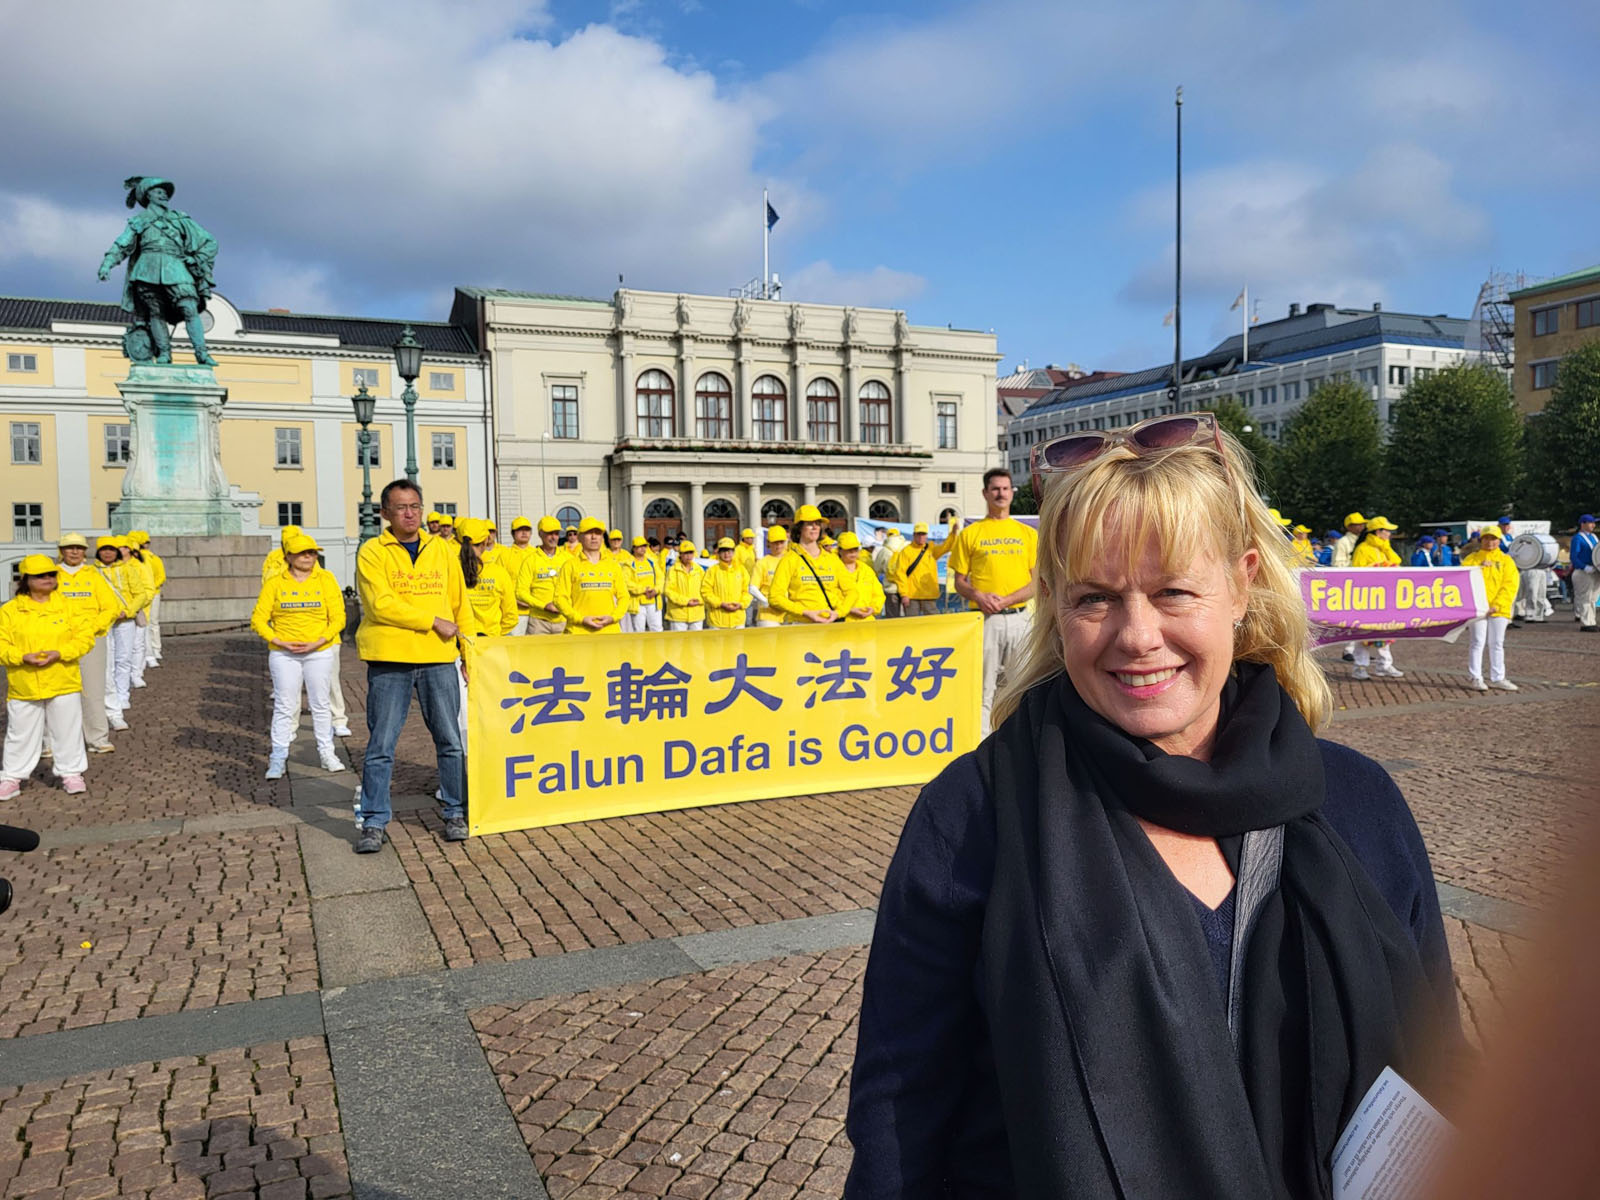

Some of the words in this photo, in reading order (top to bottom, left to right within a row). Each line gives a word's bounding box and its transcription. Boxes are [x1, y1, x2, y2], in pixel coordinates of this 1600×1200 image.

[1310, 579, 1386, 611] Falun
[1395, 578, 1464, 609] Dafa
[500, 646, 957, 734] 法輪大法好
[505, 750, 644, 798] Falun
[664, 734, 771, 780] Dafa
[788, 729, 823, 767] is
[838, 717, 954, 761] Good
